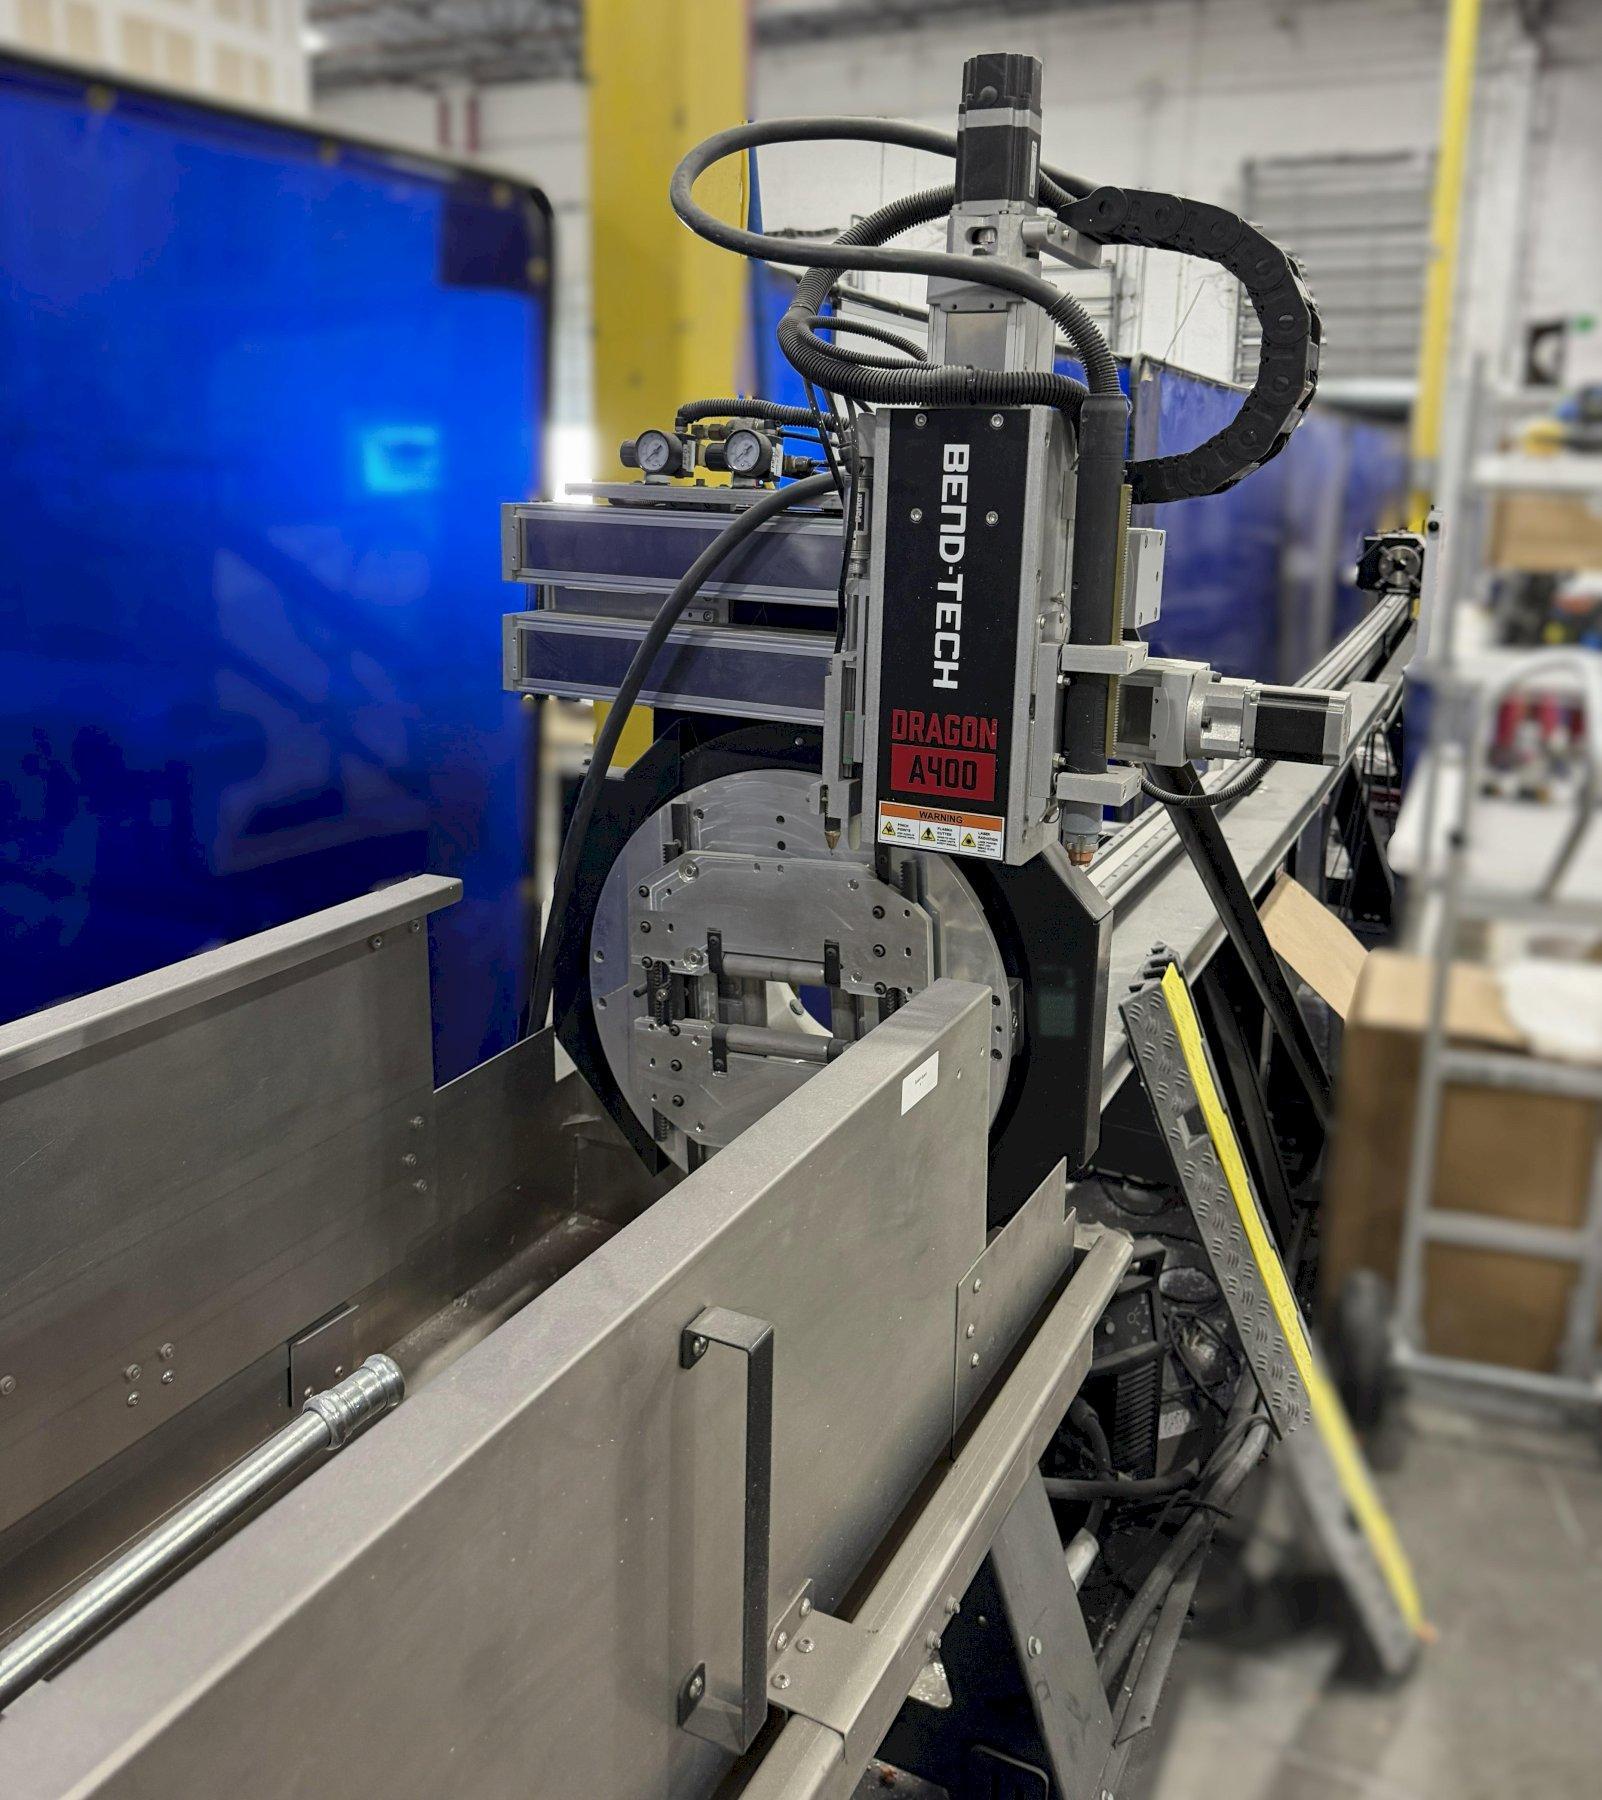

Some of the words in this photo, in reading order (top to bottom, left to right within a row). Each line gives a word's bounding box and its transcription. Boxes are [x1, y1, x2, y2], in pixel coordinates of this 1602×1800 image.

[933, 443, 970, 690] BEND-TECH
[891, 709, 998, 750] DRAGON
[908, 754, 978, 791] A400
[919, 810, 963, 824] WARNING
